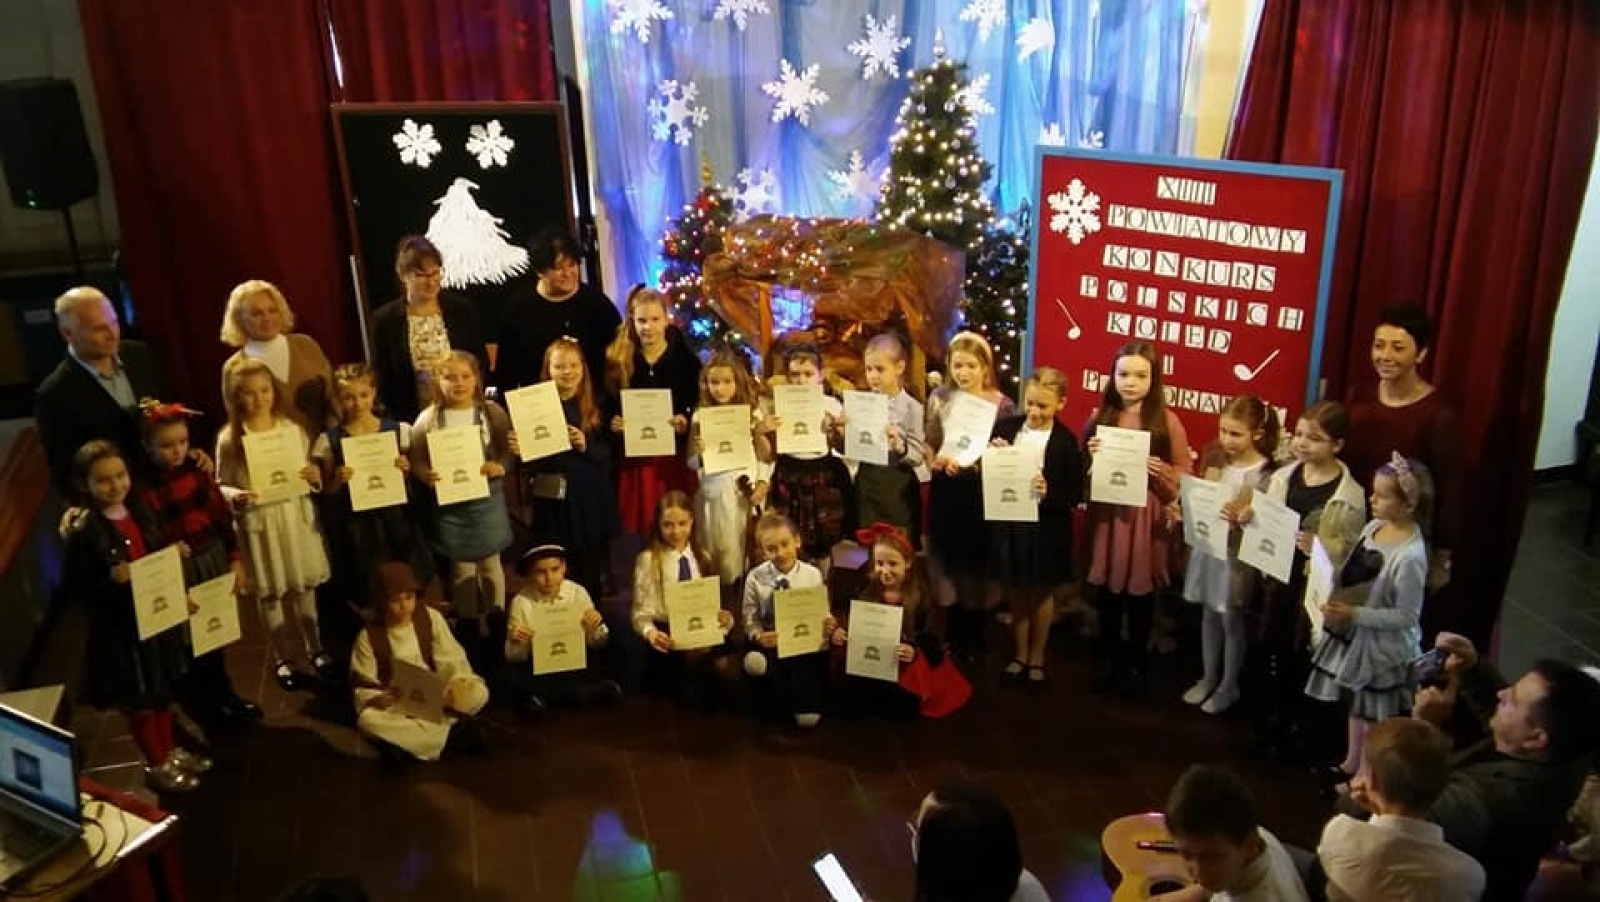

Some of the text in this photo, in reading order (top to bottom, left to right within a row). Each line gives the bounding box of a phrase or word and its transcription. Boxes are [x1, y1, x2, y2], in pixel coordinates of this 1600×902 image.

[1111, 206, 1305, 251] POWIATOWY
[1108, 246, 1274, 289] KONKURS
[1084, 276, 1301, 329] POLSKICH
